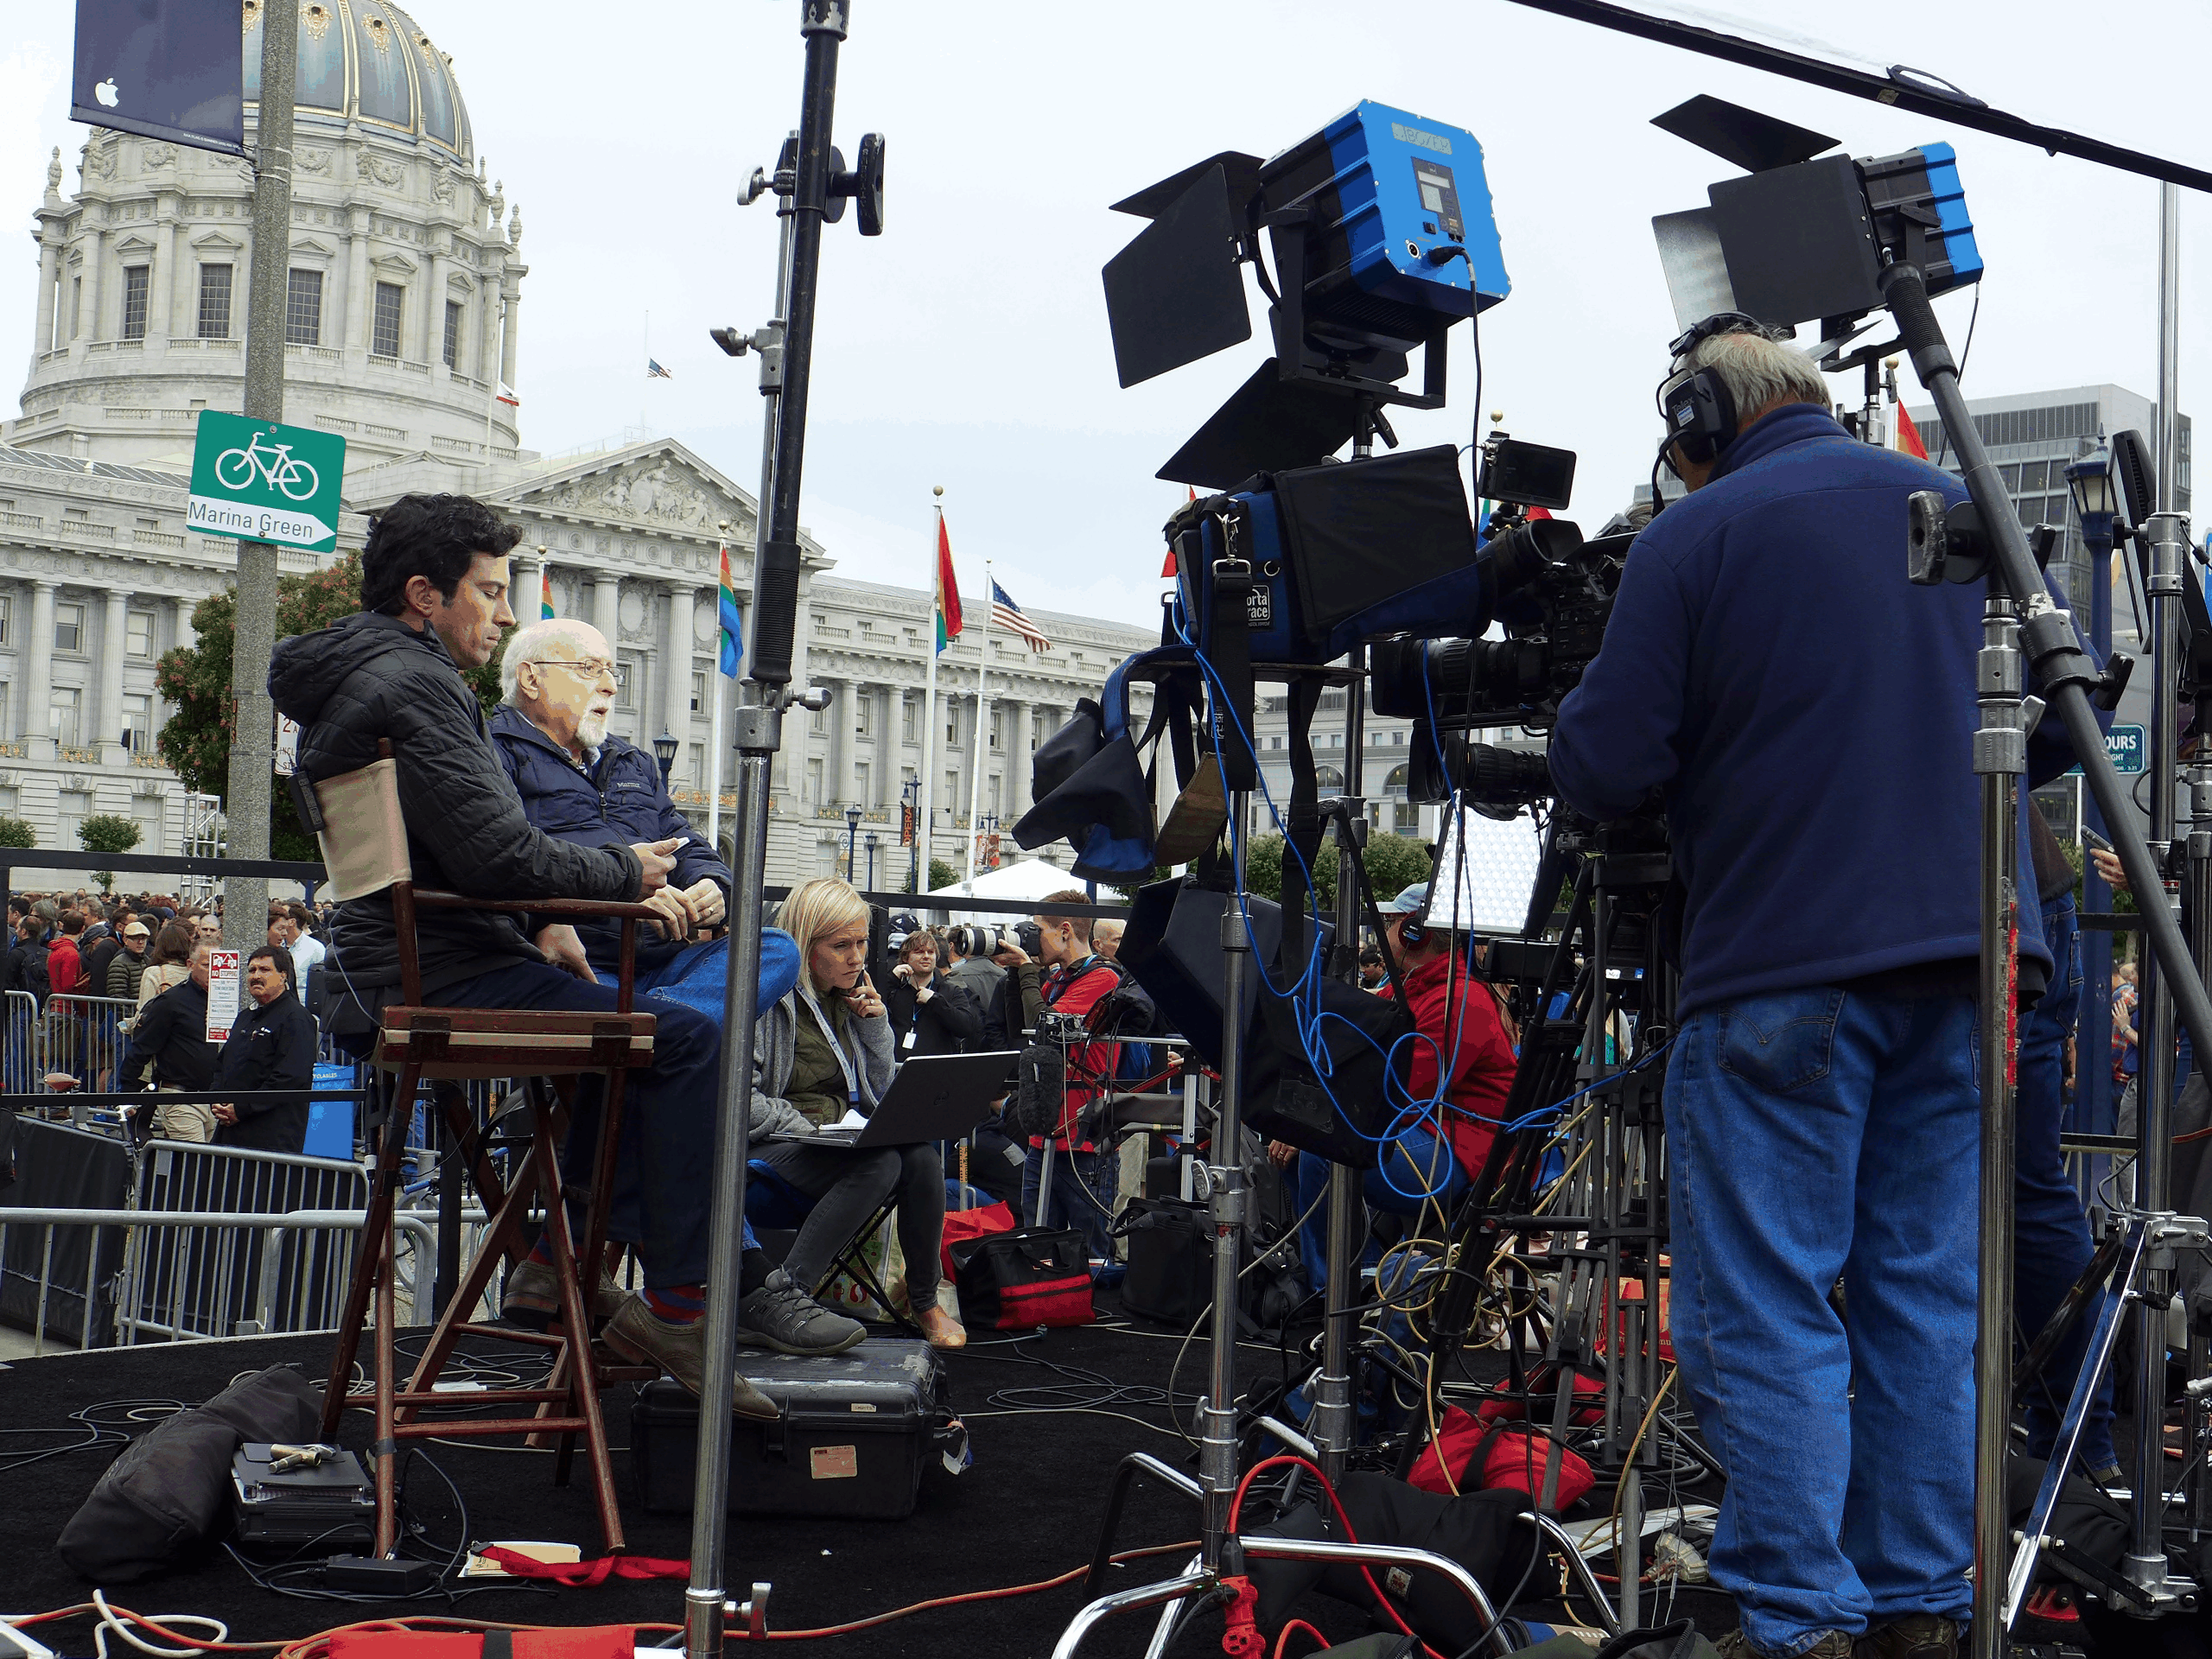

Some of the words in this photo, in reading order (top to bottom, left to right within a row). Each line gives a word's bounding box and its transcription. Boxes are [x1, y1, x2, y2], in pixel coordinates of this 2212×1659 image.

[1672, 397, 1694, 415] Telex
[188, 501, 252, 529] Marina
[259, 513, 313, 538] Green
[902, 806, 913, 847] OPERA
